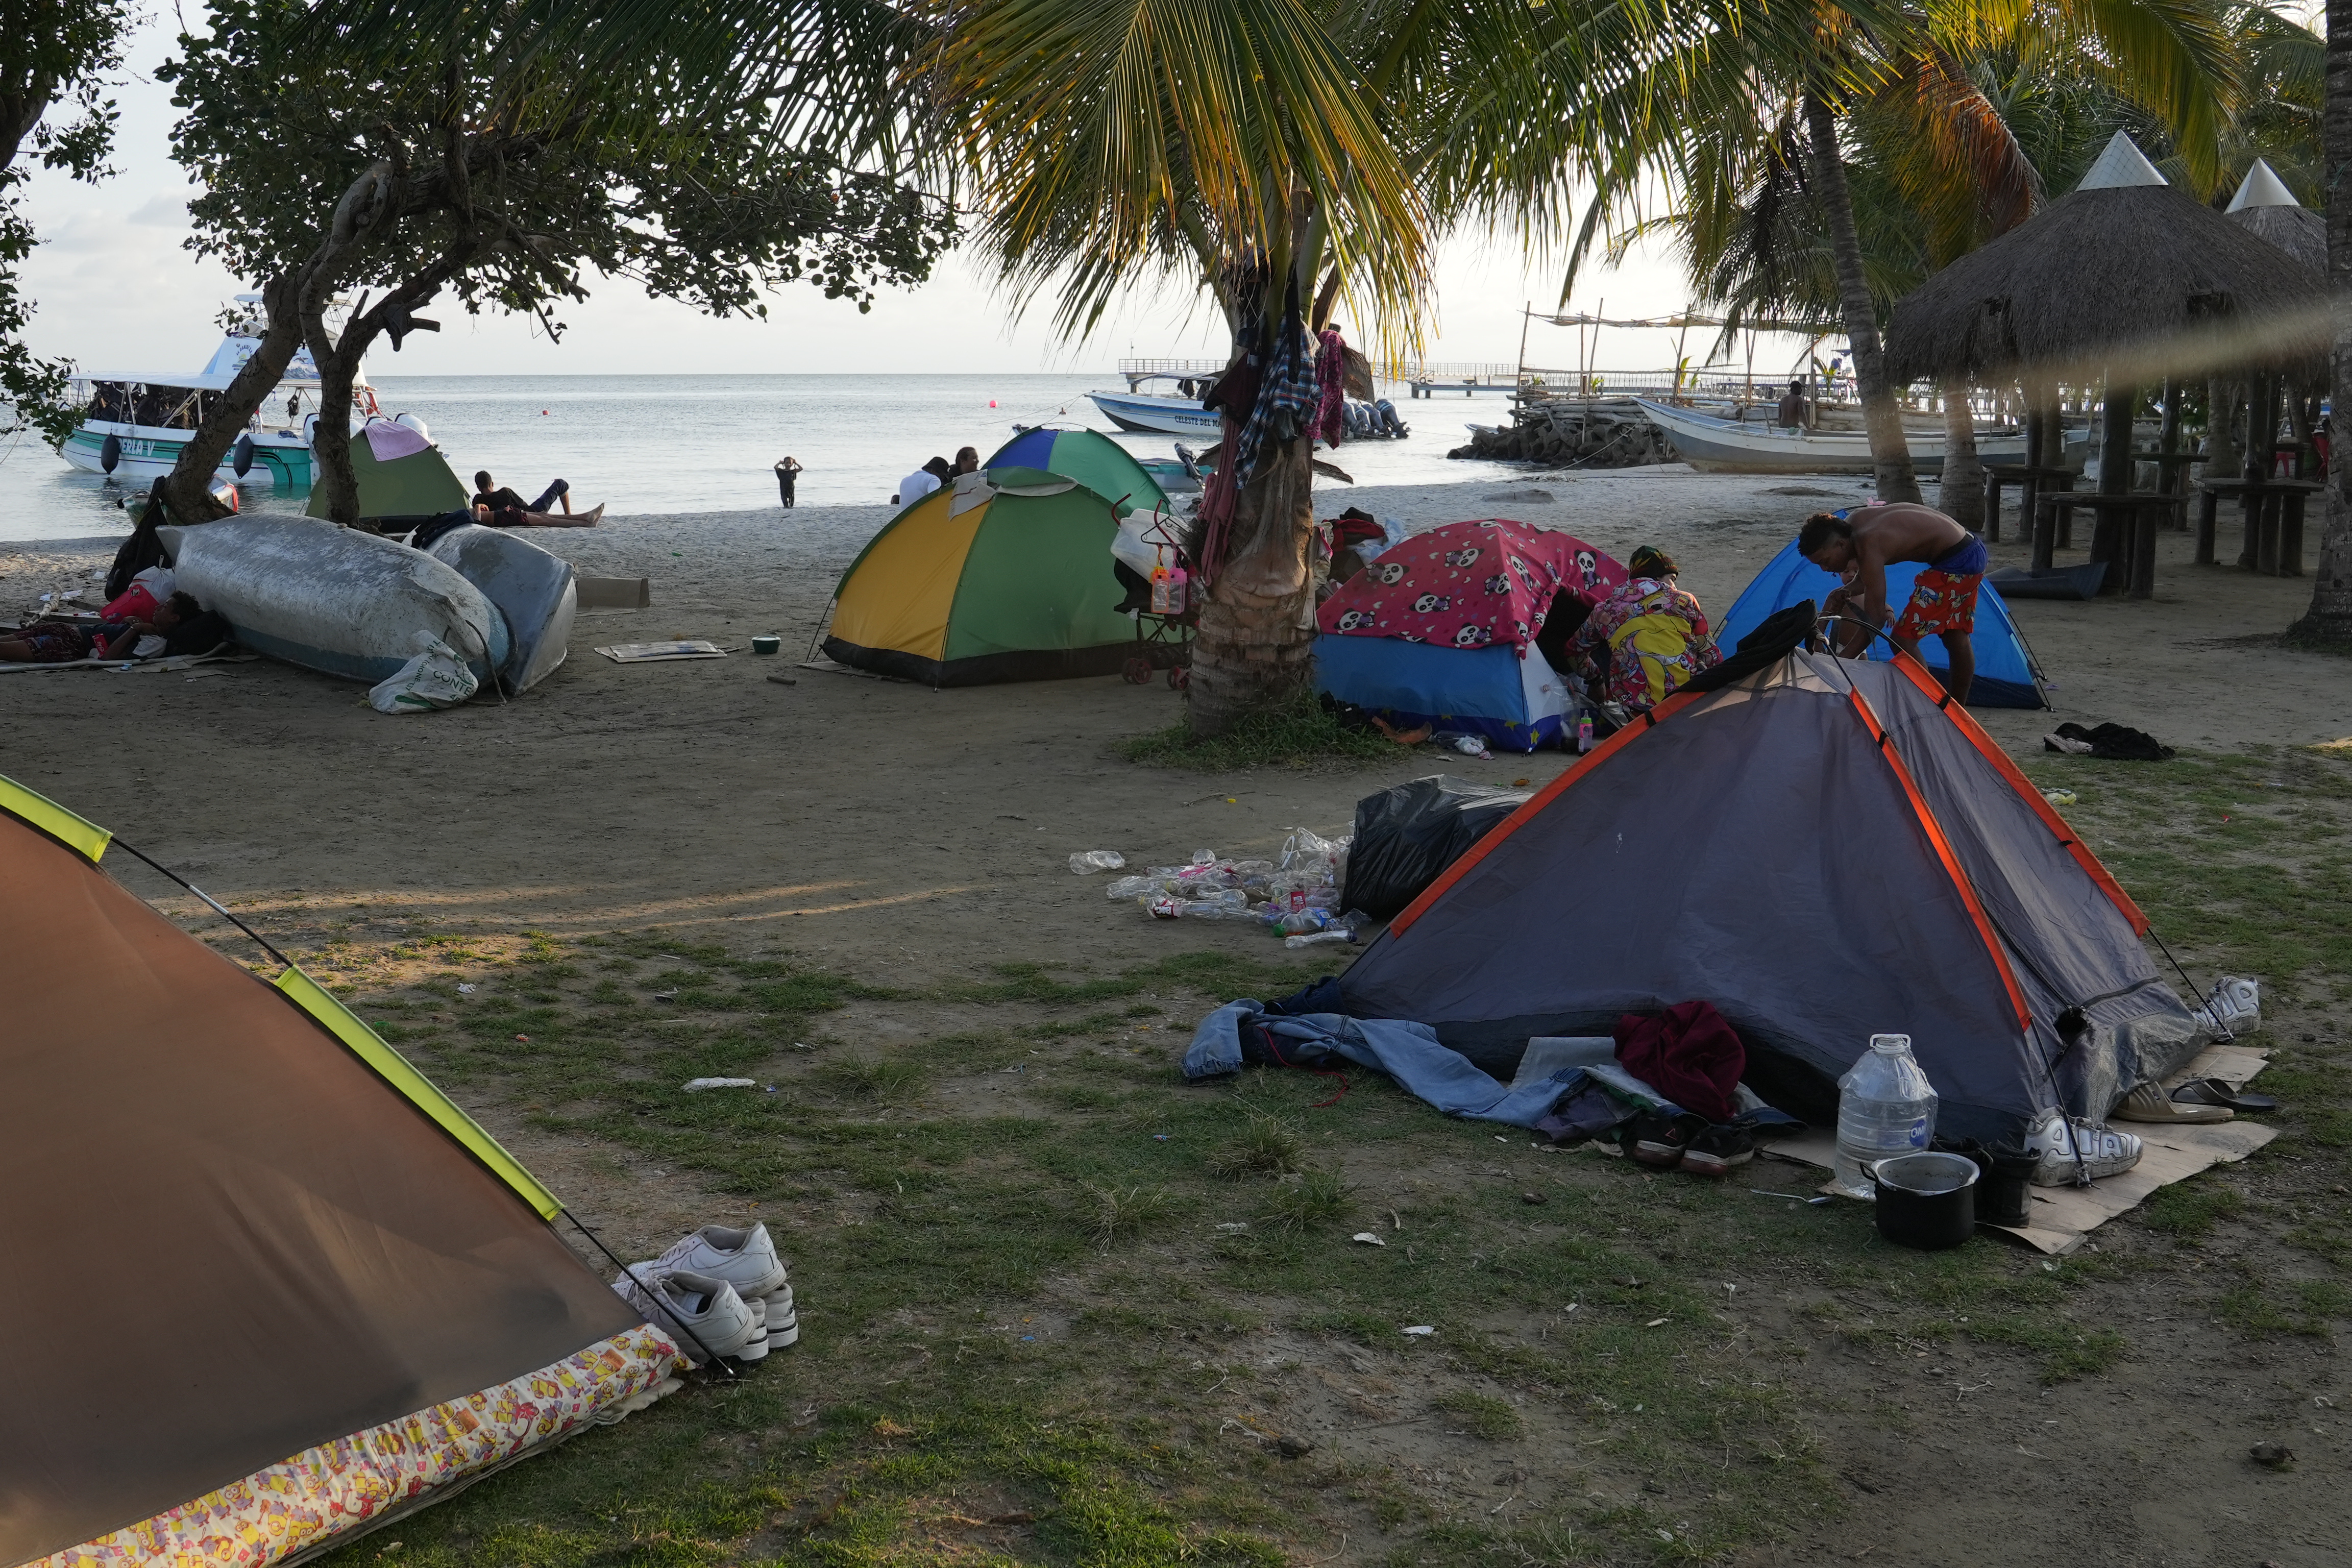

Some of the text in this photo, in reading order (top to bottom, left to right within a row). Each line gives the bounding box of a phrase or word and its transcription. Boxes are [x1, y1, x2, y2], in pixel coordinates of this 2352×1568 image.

[1175, 415, 1198, 425] CELESTE
[1200, 418, 1211, 426] DEL
[147, 441, 155, 456] V
[554, 1400, 581, 1413] BOB
[396, 1457, 426, 1472] BOB
